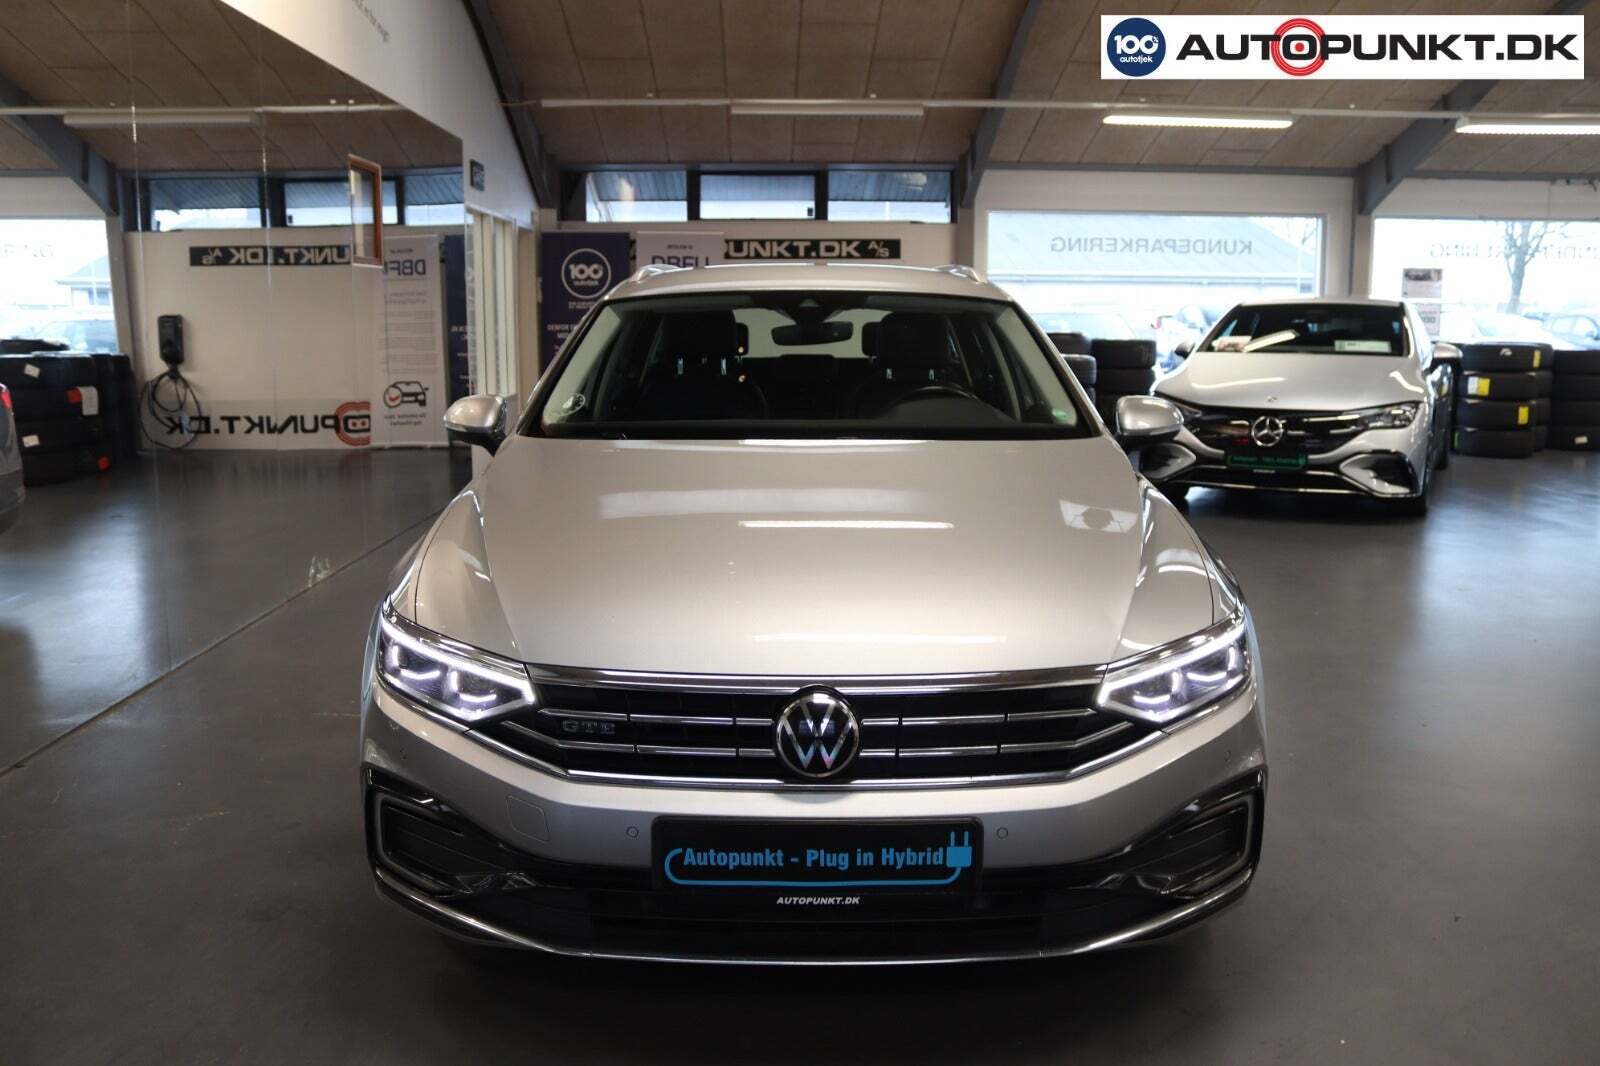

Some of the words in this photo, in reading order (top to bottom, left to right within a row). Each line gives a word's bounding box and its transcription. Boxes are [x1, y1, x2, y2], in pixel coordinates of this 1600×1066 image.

[725, 240, 861, 258] UNKT.DK
[682, 847, 784, 871] Autopunkt
[805, 848, 849, 871] Plug
[855, 847, 875, 866] in
[880, 846, 945, 869] Hybrid
[776, 895, 861, 906] AUTOPUNKT.DK
